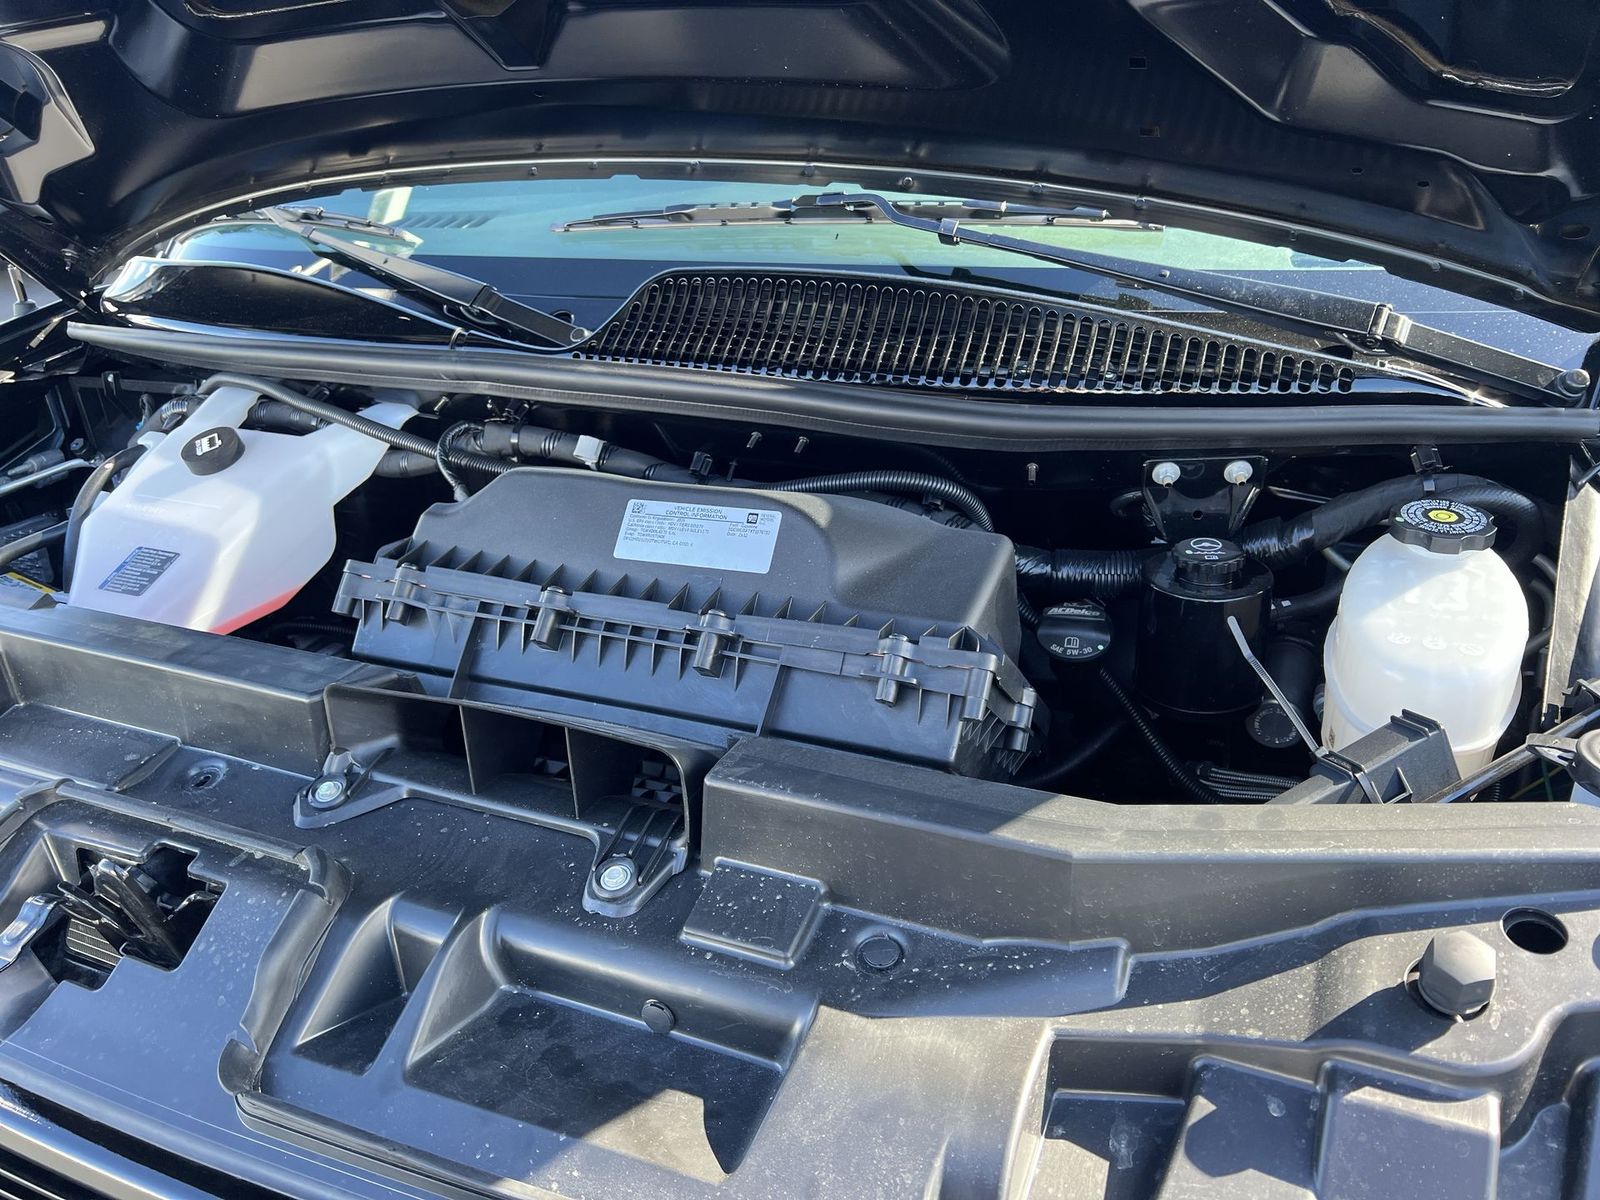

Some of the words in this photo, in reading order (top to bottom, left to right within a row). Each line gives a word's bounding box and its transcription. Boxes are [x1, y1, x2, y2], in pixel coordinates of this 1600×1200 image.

[691, 512, 728, 520] INFORMATION
[1047, 607, 1100, 616] ACDelco
[1050, 644, 1064, 653] SAE
[1066, 646, 1093, 655] 5W-30
